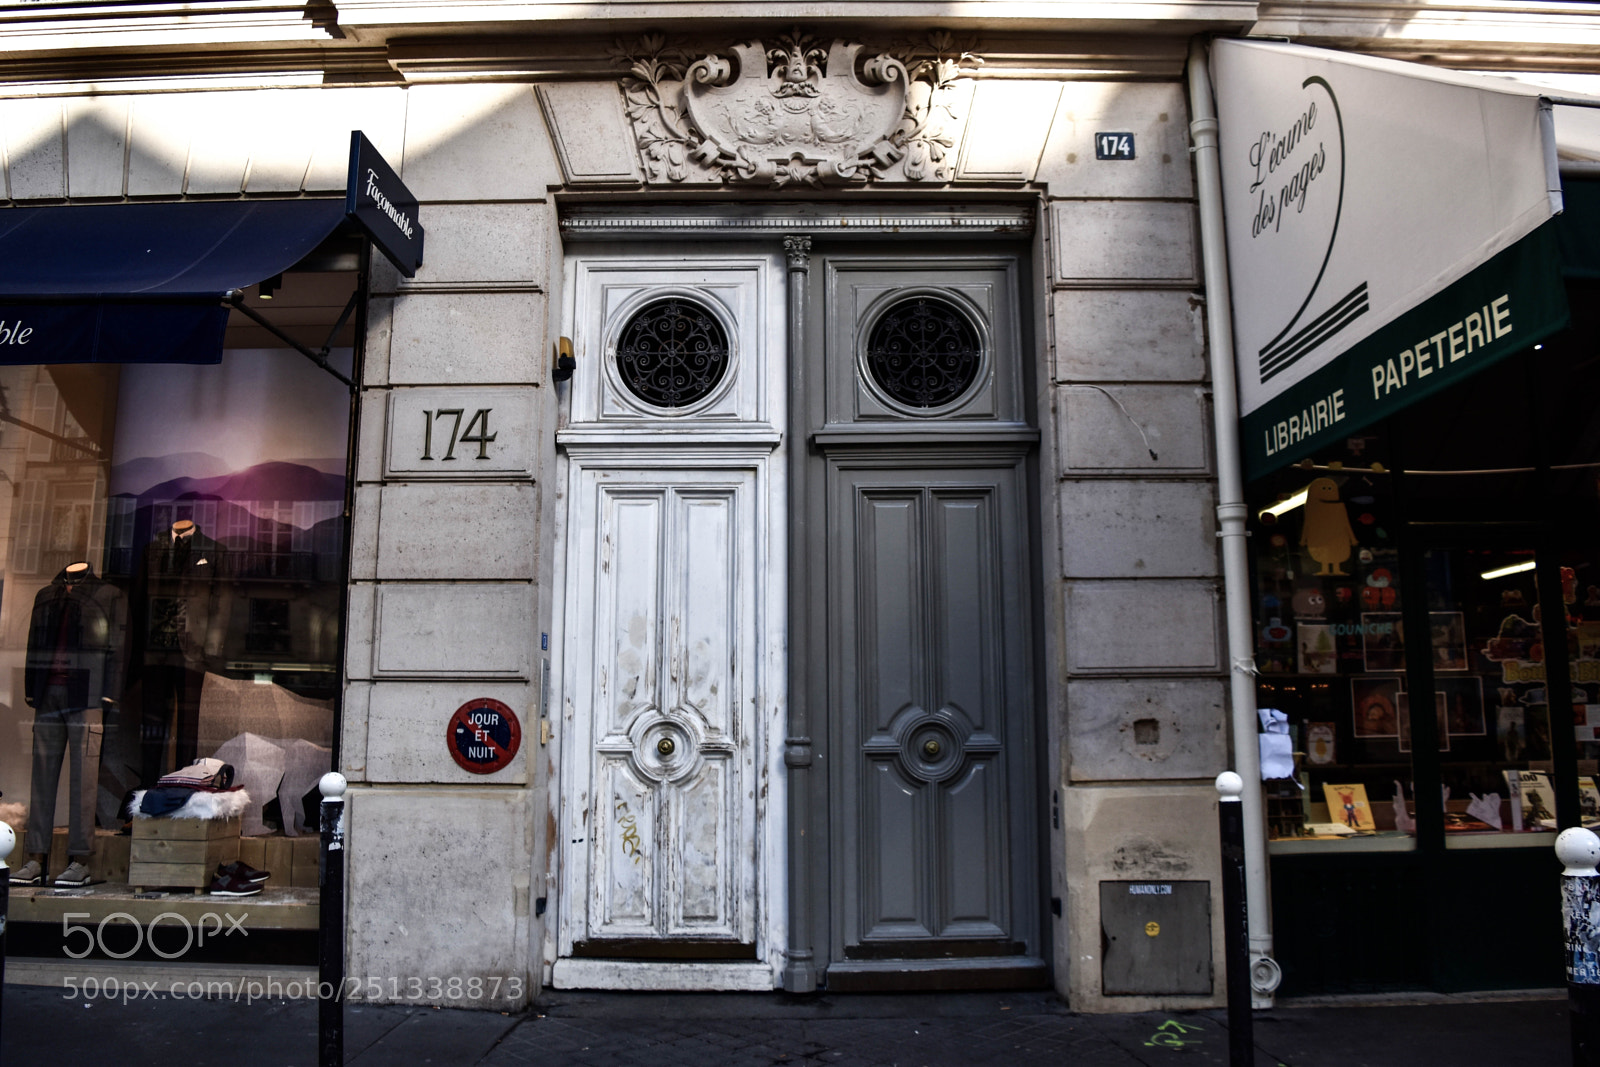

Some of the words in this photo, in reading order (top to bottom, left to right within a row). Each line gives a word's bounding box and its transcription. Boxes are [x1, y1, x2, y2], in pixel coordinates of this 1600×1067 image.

[1101, 136, 1130, 155] 174
[1249, 102, 1318, 194] L'écume
[366, 168, 413, 240] Façonnable
[1252, 190, 1275, 238] des
[1276, 142, 1326, 233] pages
[1265, 389, 1346, 457] LIBRAIRIE
[1371, 294, 1513, 400] PAPETERIE
[420, 408, 498, 461] 174
[468, 713, 499, 725] JOUR
[475, 730, 490, 742] ET
[468, 746, 496, 758] NUIT
